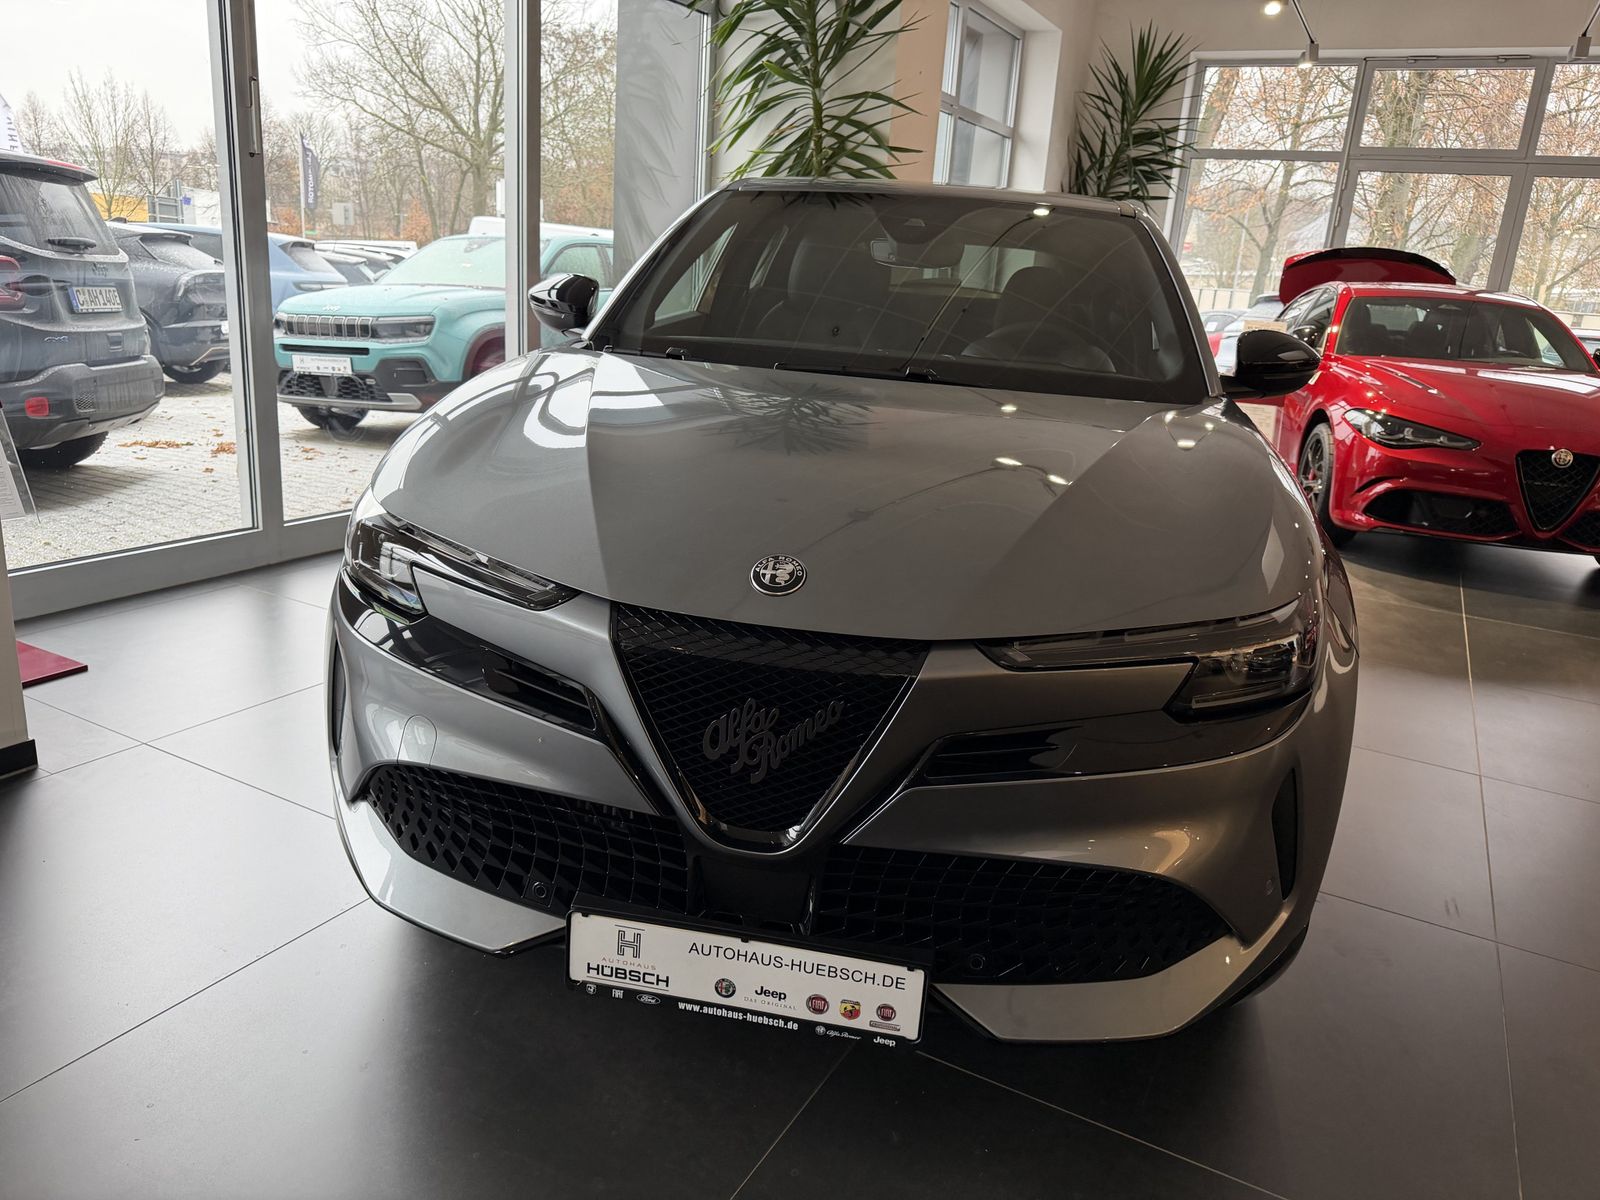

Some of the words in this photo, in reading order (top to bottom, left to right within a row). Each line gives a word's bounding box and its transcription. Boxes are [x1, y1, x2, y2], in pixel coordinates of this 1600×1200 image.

[75, 289, 85, 307] C
[755, 557, 775, 572] ALFA
[778, 556, 803, 576] ROMEO
[702, 697, 780, 775] Alfa
[745, 700, 845, 785] Romeo
[601, 956, 657, 971] AUTOHAUS
[688, 941, 907, 991] AUTOHAUS-HUEBSCH.DE
[586, 961, 670, 988] HÜBSCH
[611, 988, 625, 999] FIAT
[754, 985, 787, 1002] Jeep
[760, 999, 798, 1011] ORIGINAL
[811, 998, 825, 1010] FIAT
[880, 1007, 893, 1018] FIAT
[677, 1000, 799, 1031] www.autohaus-huebsch.de
[826, 1029, 841, 1038] Alfa
[873, 1035, 897, 1048] Jeep
